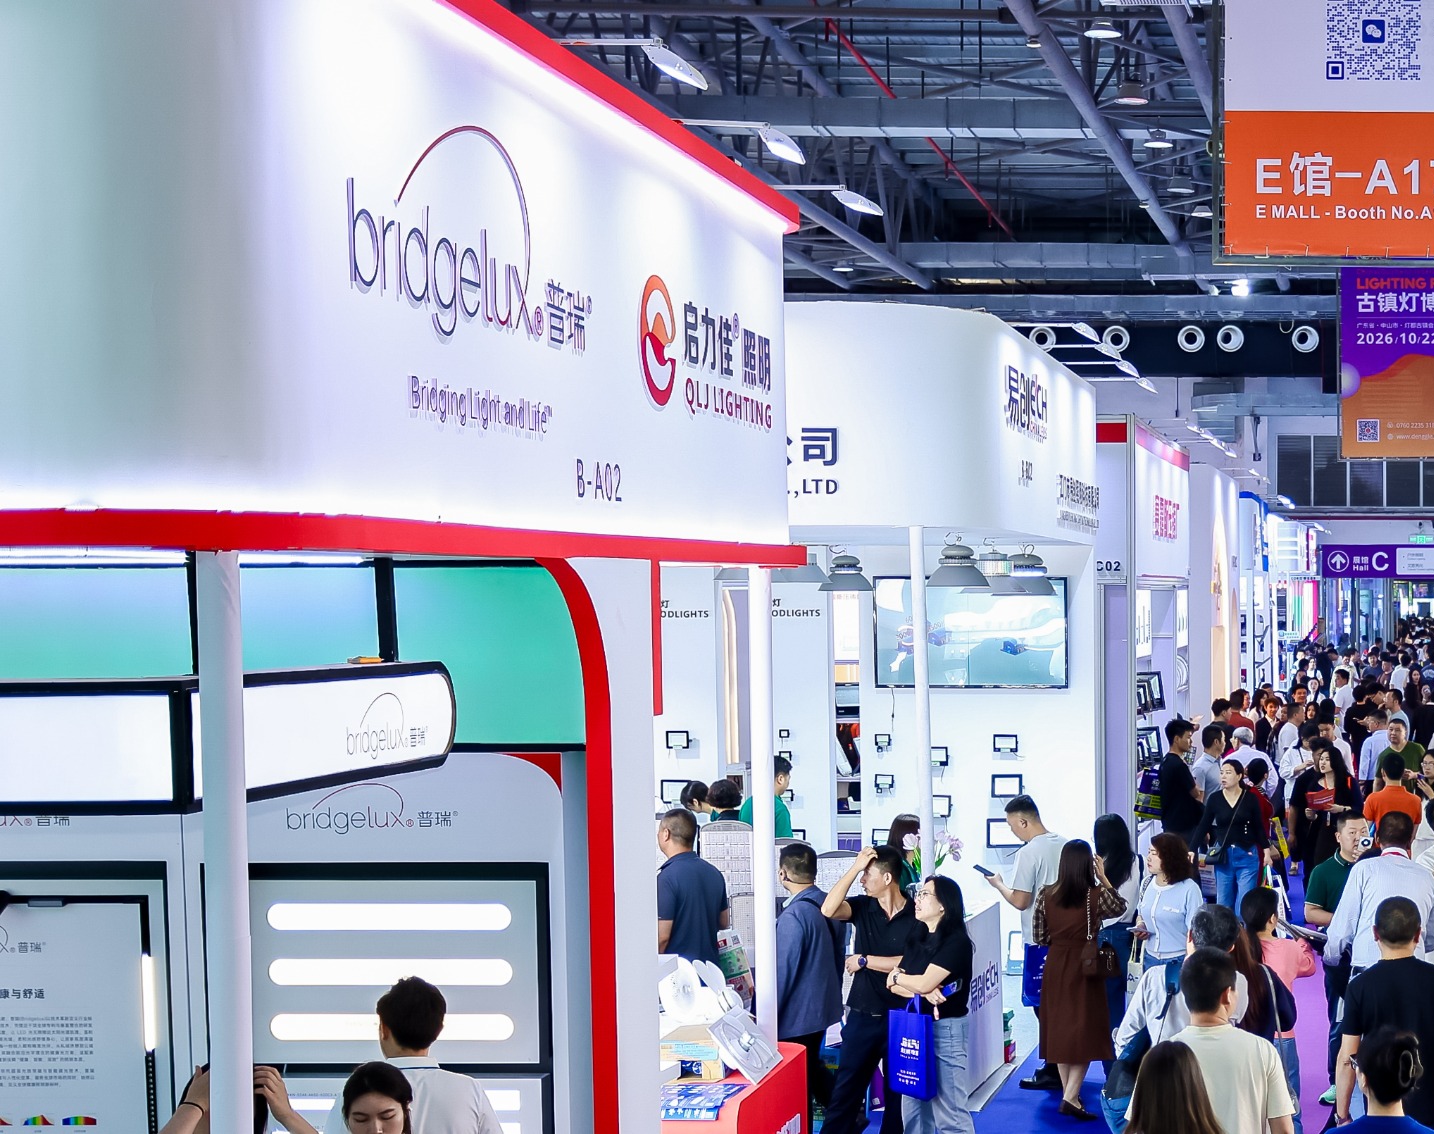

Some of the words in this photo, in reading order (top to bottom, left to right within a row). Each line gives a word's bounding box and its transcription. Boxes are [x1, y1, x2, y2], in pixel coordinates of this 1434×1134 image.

[1256, 205, 1268, 219] E
[1271, 205, 1321, 219] MALL
[1335, 205, 1387, 221] Booth
[1356, 277, 1427, 290] LIGHTING
[408, 375, 467, 427] Bridging
[468, 387, 502, 431] Light
[503, 397, 525, 430] and
[685, 377, 710, 416] QLJ
[713, 385, 772, 430] LIGHTING
[576, 458, 622, 502] B-A02
[1352, 556, 1369, 564] 展馆
[1352, 564, 1369, 572] Hall
[1372, 551, 1389, 571] C
